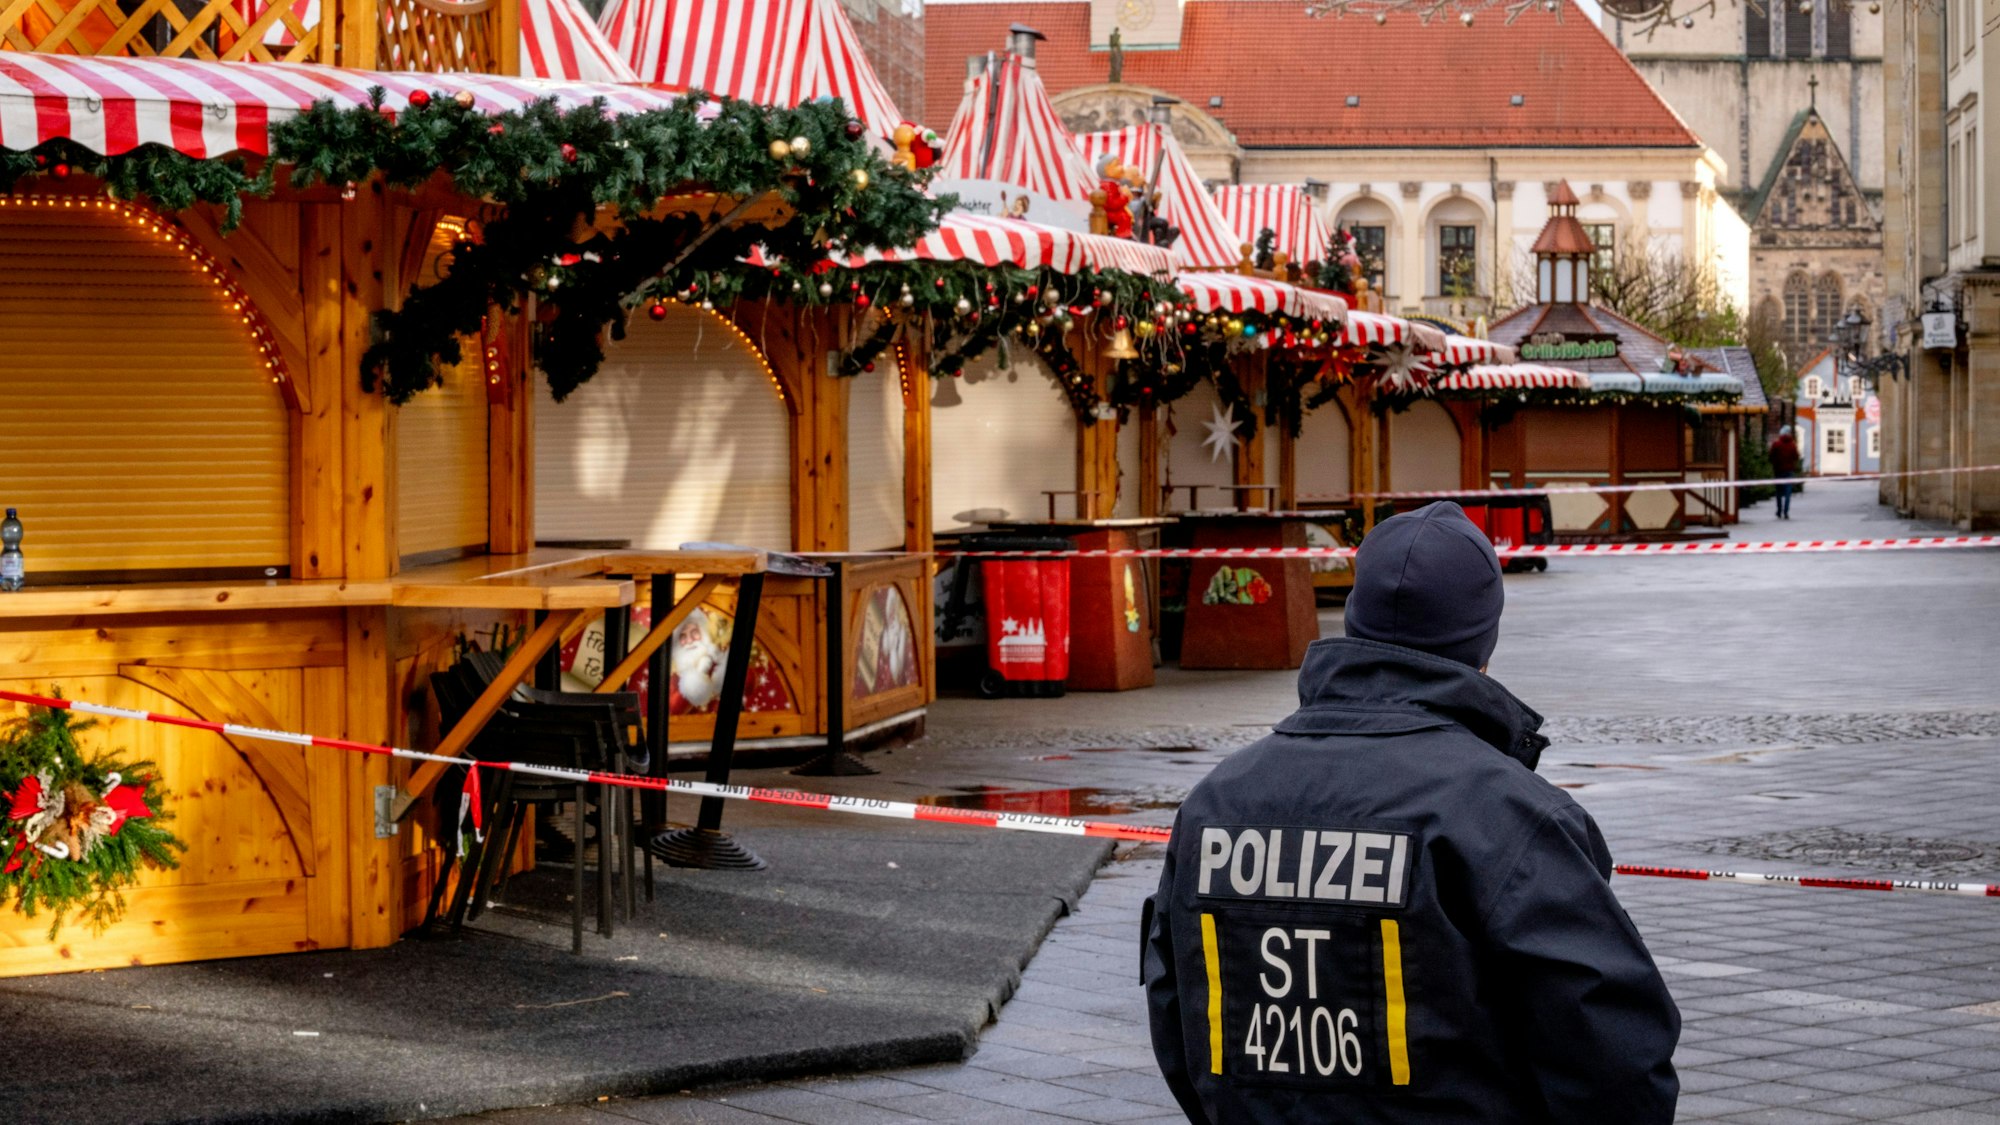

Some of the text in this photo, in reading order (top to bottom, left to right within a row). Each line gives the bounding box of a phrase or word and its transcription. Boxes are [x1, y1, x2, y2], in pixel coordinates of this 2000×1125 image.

[1198, 828, 1408, 904] POLIZEI
[1259, 927, 1331, 999] ST
[1244, 1003, 1362, 1077] 42106
